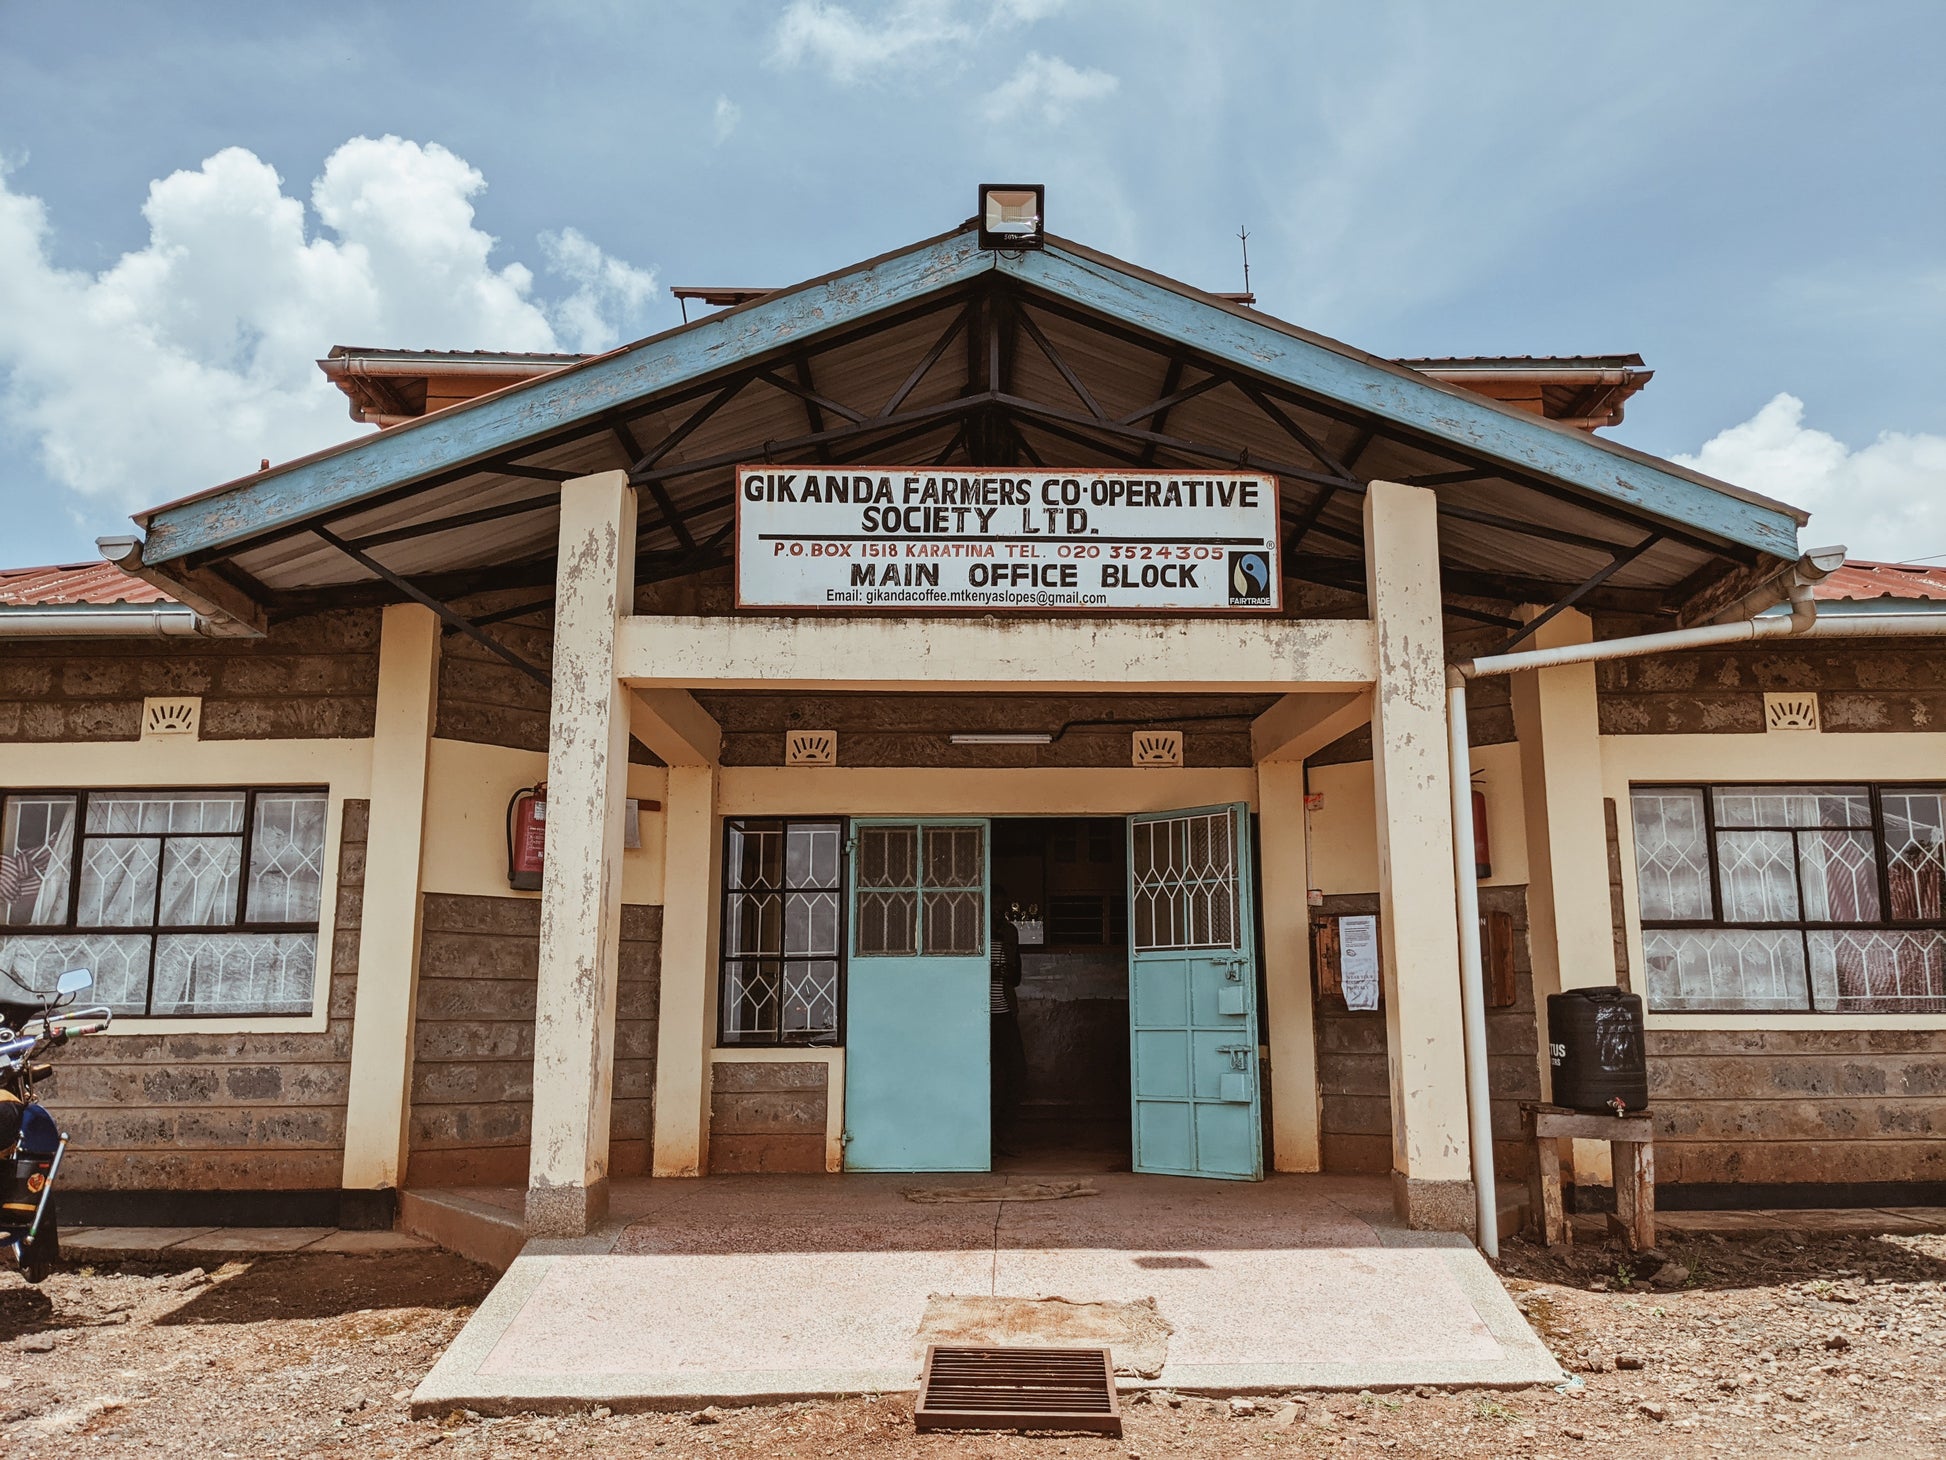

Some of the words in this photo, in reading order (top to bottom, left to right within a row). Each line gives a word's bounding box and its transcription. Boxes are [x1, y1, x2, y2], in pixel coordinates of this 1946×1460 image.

[744, 475, 894, 504] GIKANDA
[903, 477, 1032, 506] FARMERS
[862, 506, 998, 533] SOCIETY
[1022, 508, 1099, 535] LTD.
[861, 543, 898, 558] 1518
[905, 544, 995, 559] KARATINA
[1005, 544, 1047, 559] TEL.
[1057, 545, 1100, 560] 020
[1109, 546, 1224, 561] 3524305
[850, 563, 939, 587] MAIN
[968, 563, 1078, 588] OFFICE
[1101, 564, 1199, 589] BLOCK
[826, 589, 862, 602] Email:
[866, 588, 1107, 606] gikandacoffee.mtkenyaslopes@gmail.com
[1229, 597, 1271, 605] FAIRTRADE
